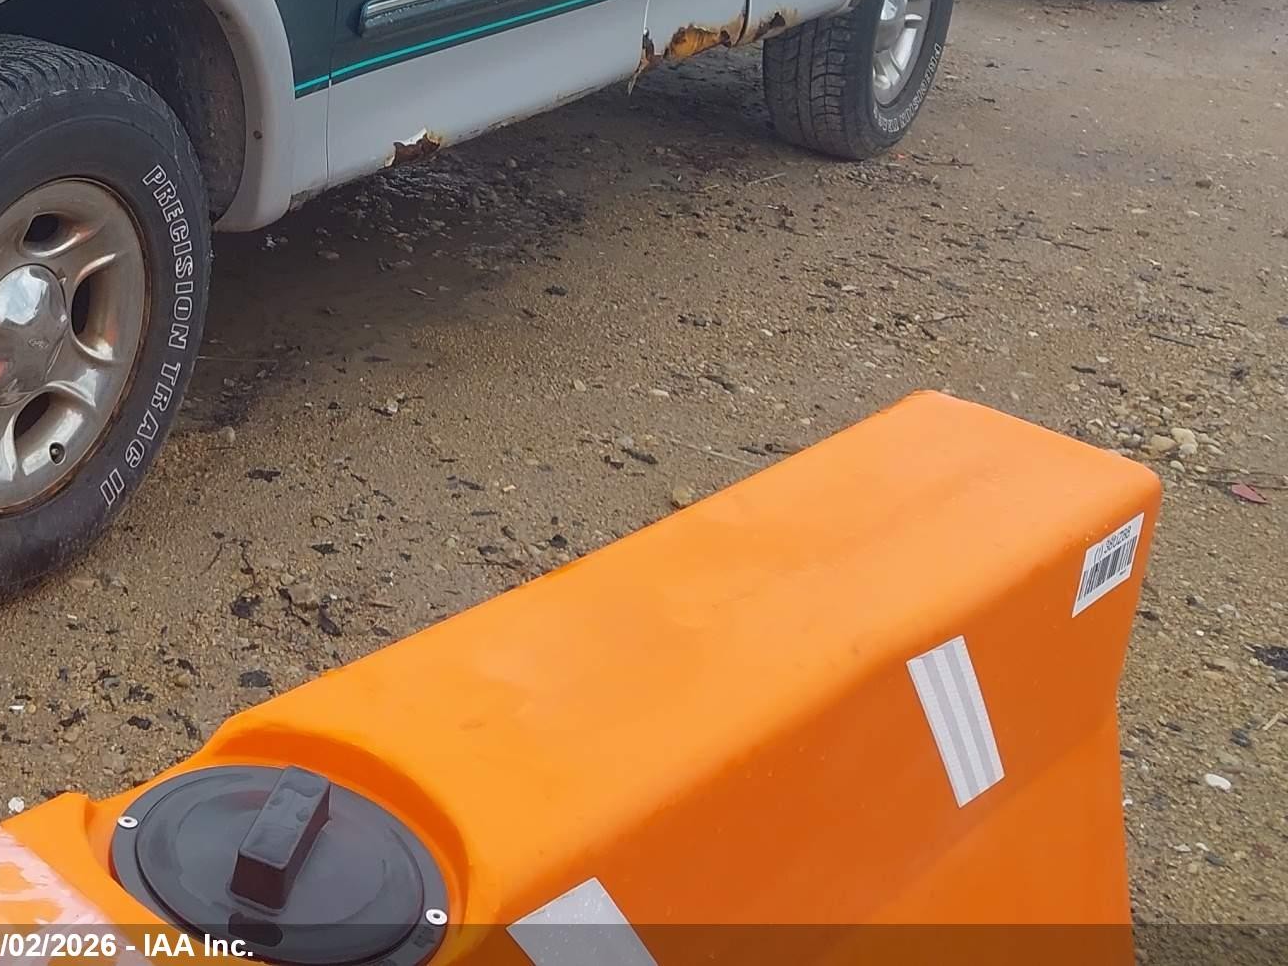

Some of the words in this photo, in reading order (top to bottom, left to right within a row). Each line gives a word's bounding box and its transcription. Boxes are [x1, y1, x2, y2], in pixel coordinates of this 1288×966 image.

[142, 164, 194, 350] PRECISION
[124, 362, 181, 468] TRAC
[100, 468, 125, 507] II
